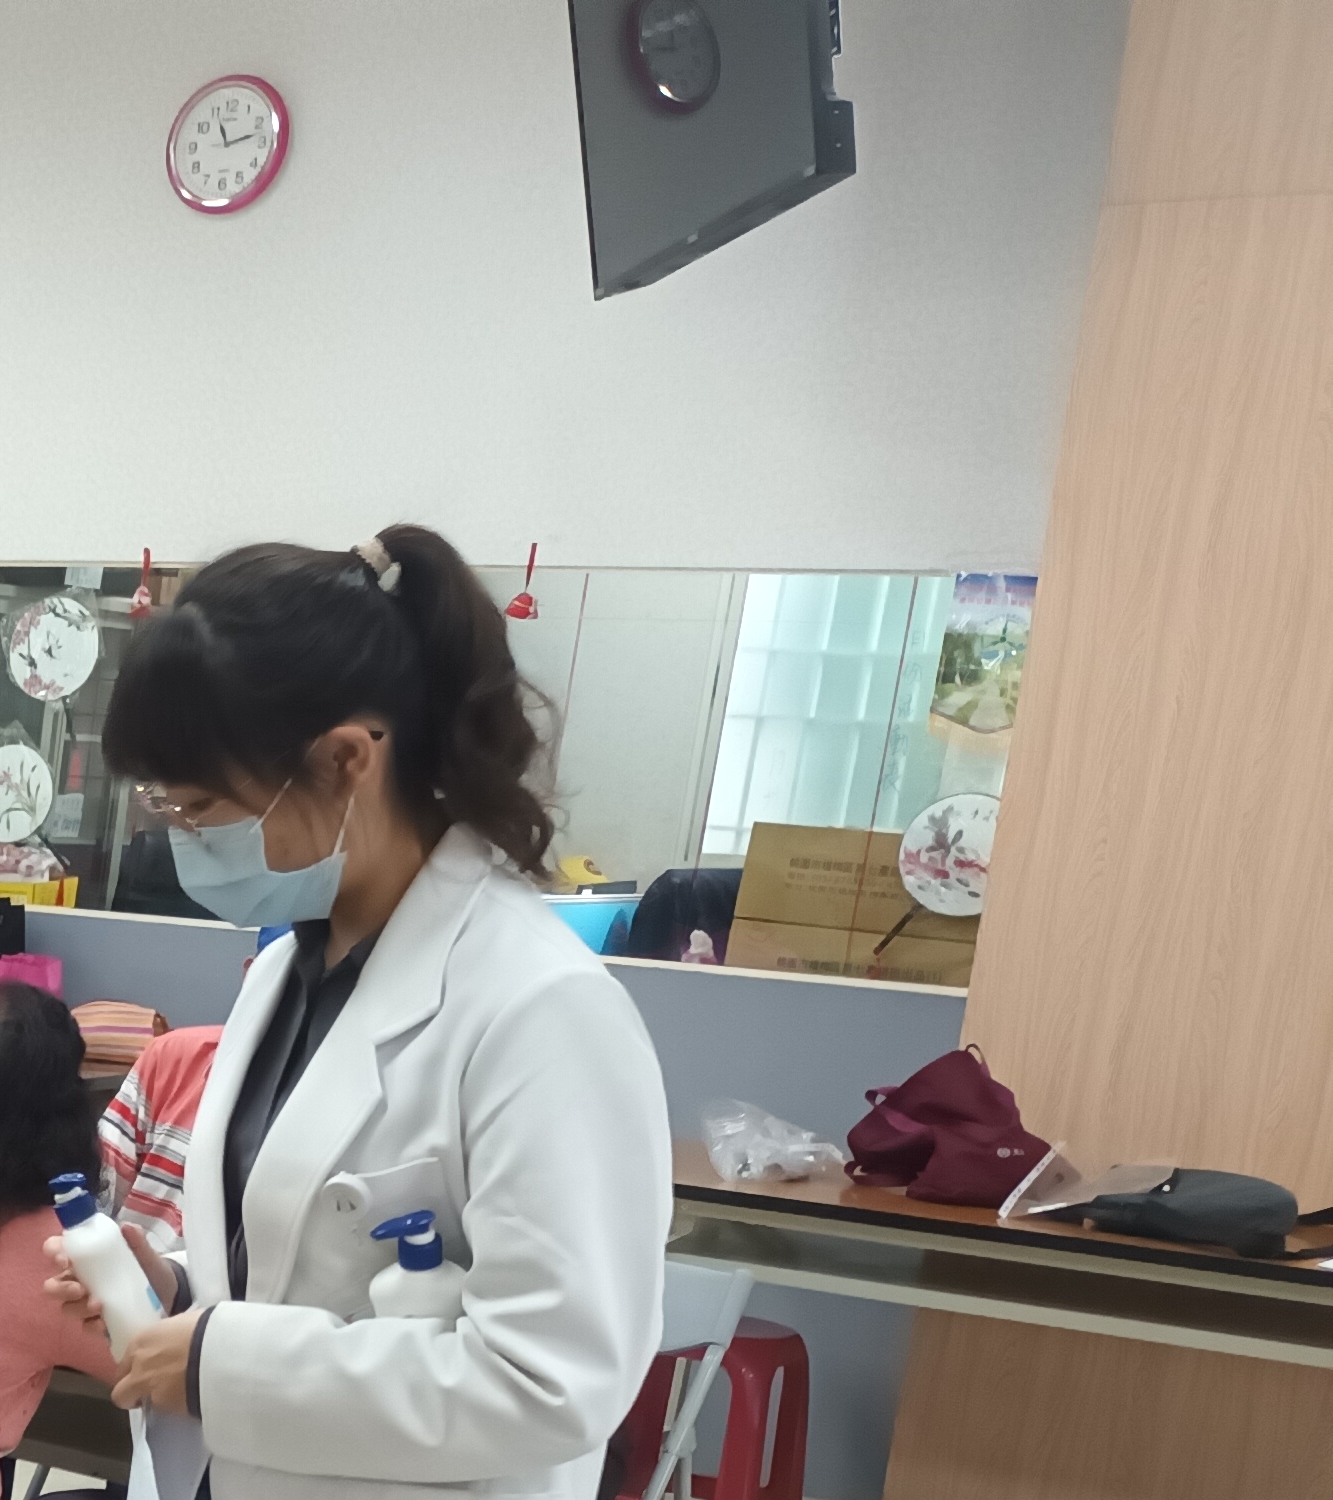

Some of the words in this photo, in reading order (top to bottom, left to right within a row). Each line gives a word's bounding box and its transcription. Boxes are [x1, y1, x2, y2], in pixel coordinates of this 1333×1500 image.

[226, 99, 239, 112] 12
[212, 106, 220, 119] 11
[197, 121, 210, 135] 10
[254, 116, 264, 130] 2
[188, 141, 197, 155] 9
[257, 136, 266, 149] 3
[192, 161, 200, 174] 8
[249, 157, 257, 169] 4
[203, 174, 210, 187] 7
[218, 177, 227, 191] 6
[235, 171, 244, 185] 5
